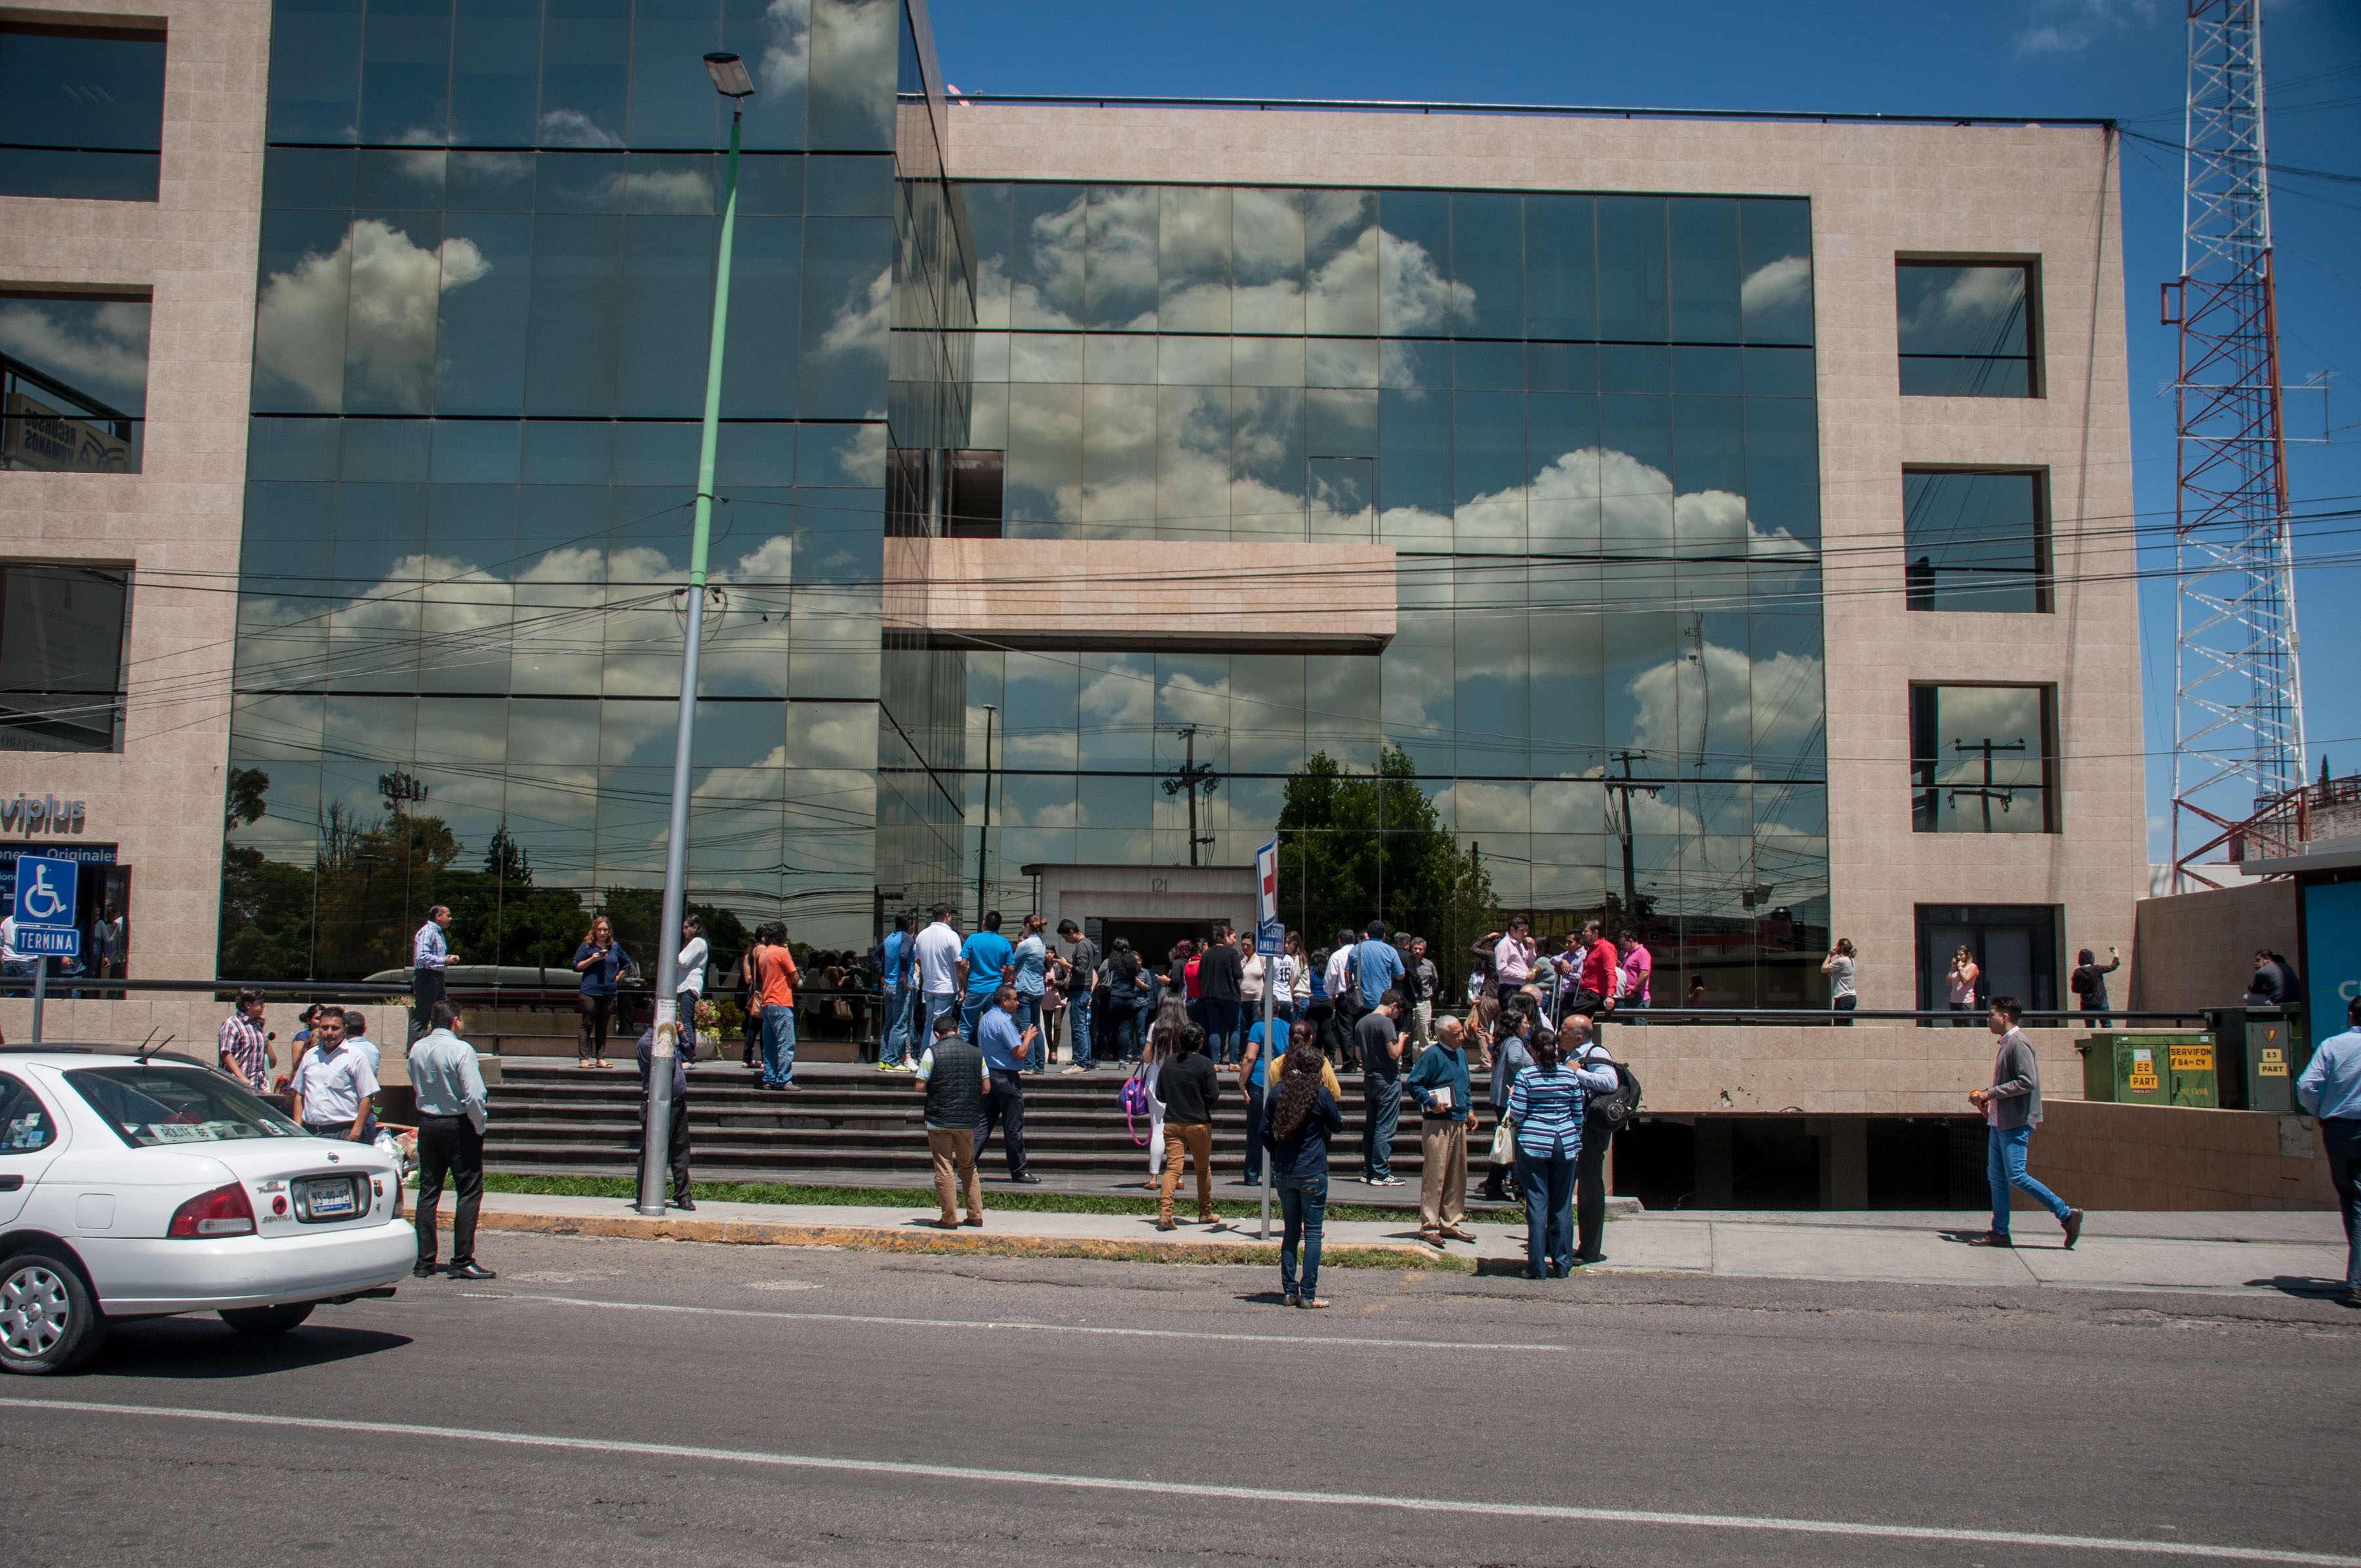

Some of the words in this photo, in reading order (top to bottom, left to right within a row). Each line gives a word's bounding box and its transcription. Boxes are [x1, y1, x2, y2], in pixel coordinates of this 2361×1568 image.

[1152, 878, 1167, 893] 121
[20, 932, 73, 951] TERMINA
[1280, 967, 1291, 982] 16
[2137, 1063, 2150, 1072] E2
[2133, 1077, 2155, 1086] PART
[161, 1128, 195, 1138] ROUTE
[195, 1128, 210, 1137] 66
[262, 1214, 294, 1224] SENTRA
